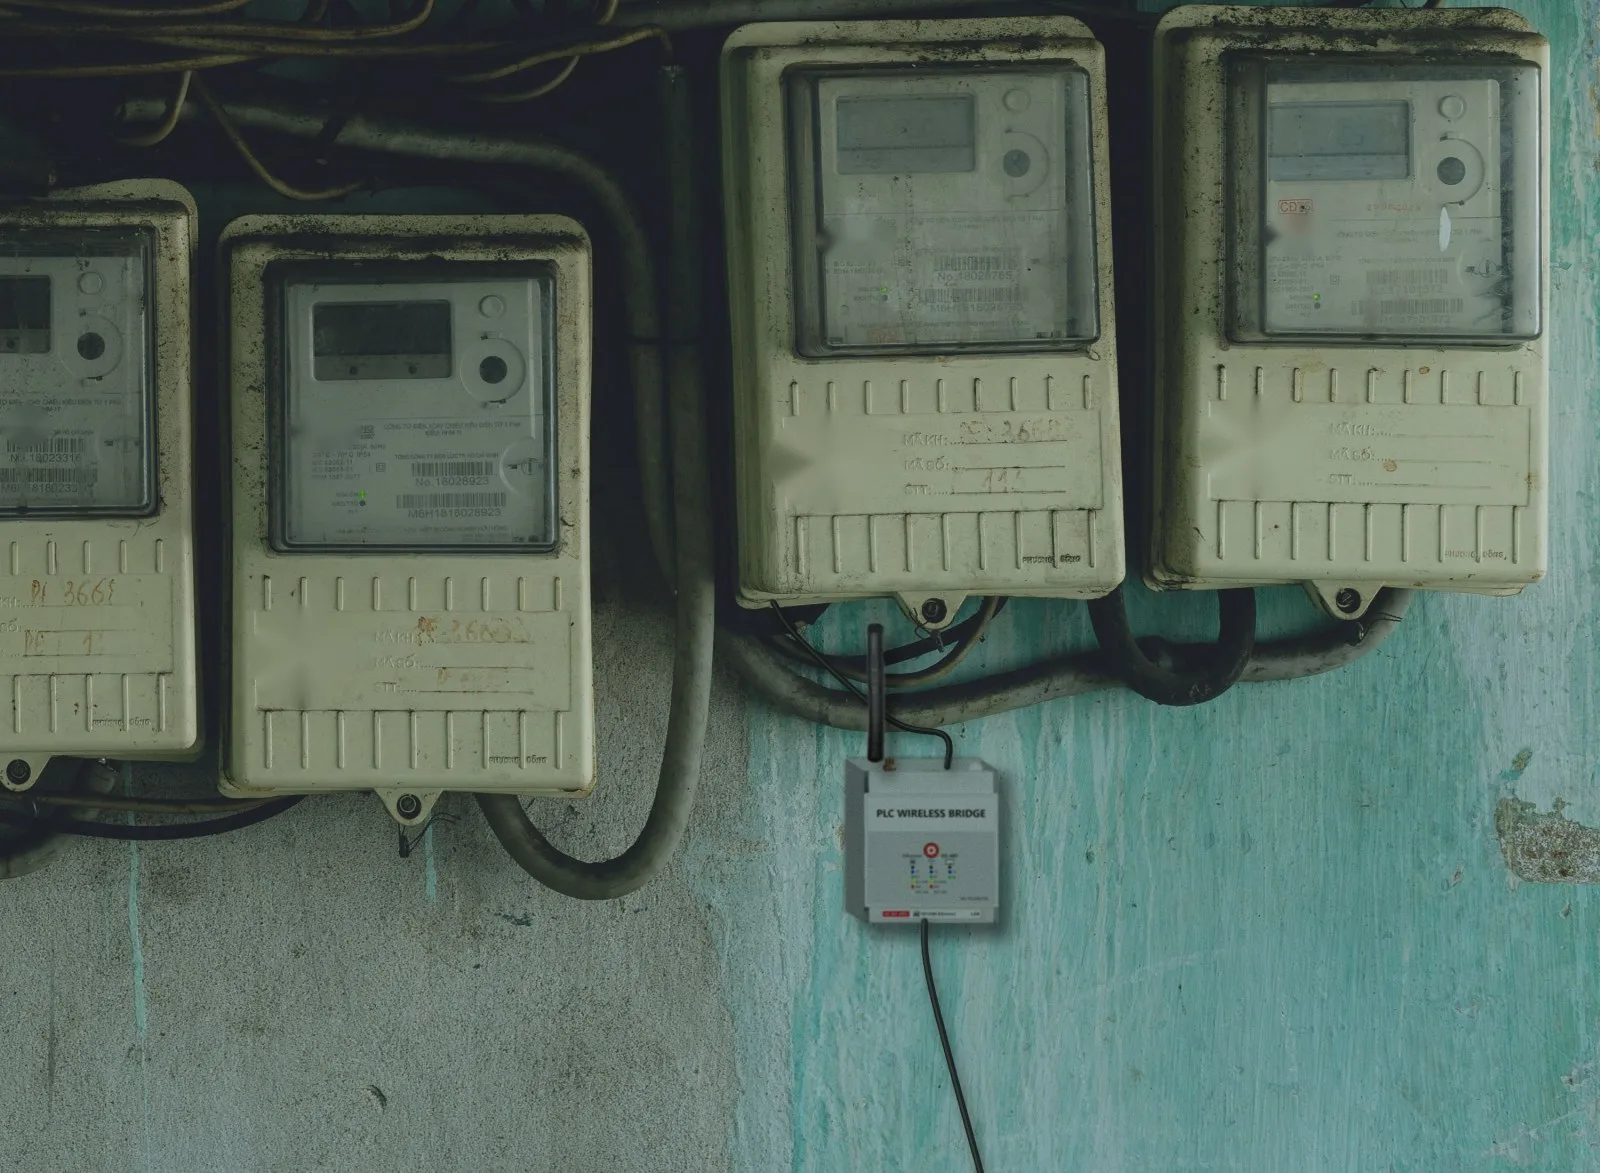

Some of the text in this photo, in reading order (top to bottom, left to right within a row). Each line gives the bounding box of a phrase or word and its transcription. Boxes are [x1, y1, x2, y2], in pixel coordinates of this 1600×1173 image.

[416, 477, 489, 487] No.18028923
[876, 809, 986, 818] PLC WIRELESS BRIDGE
